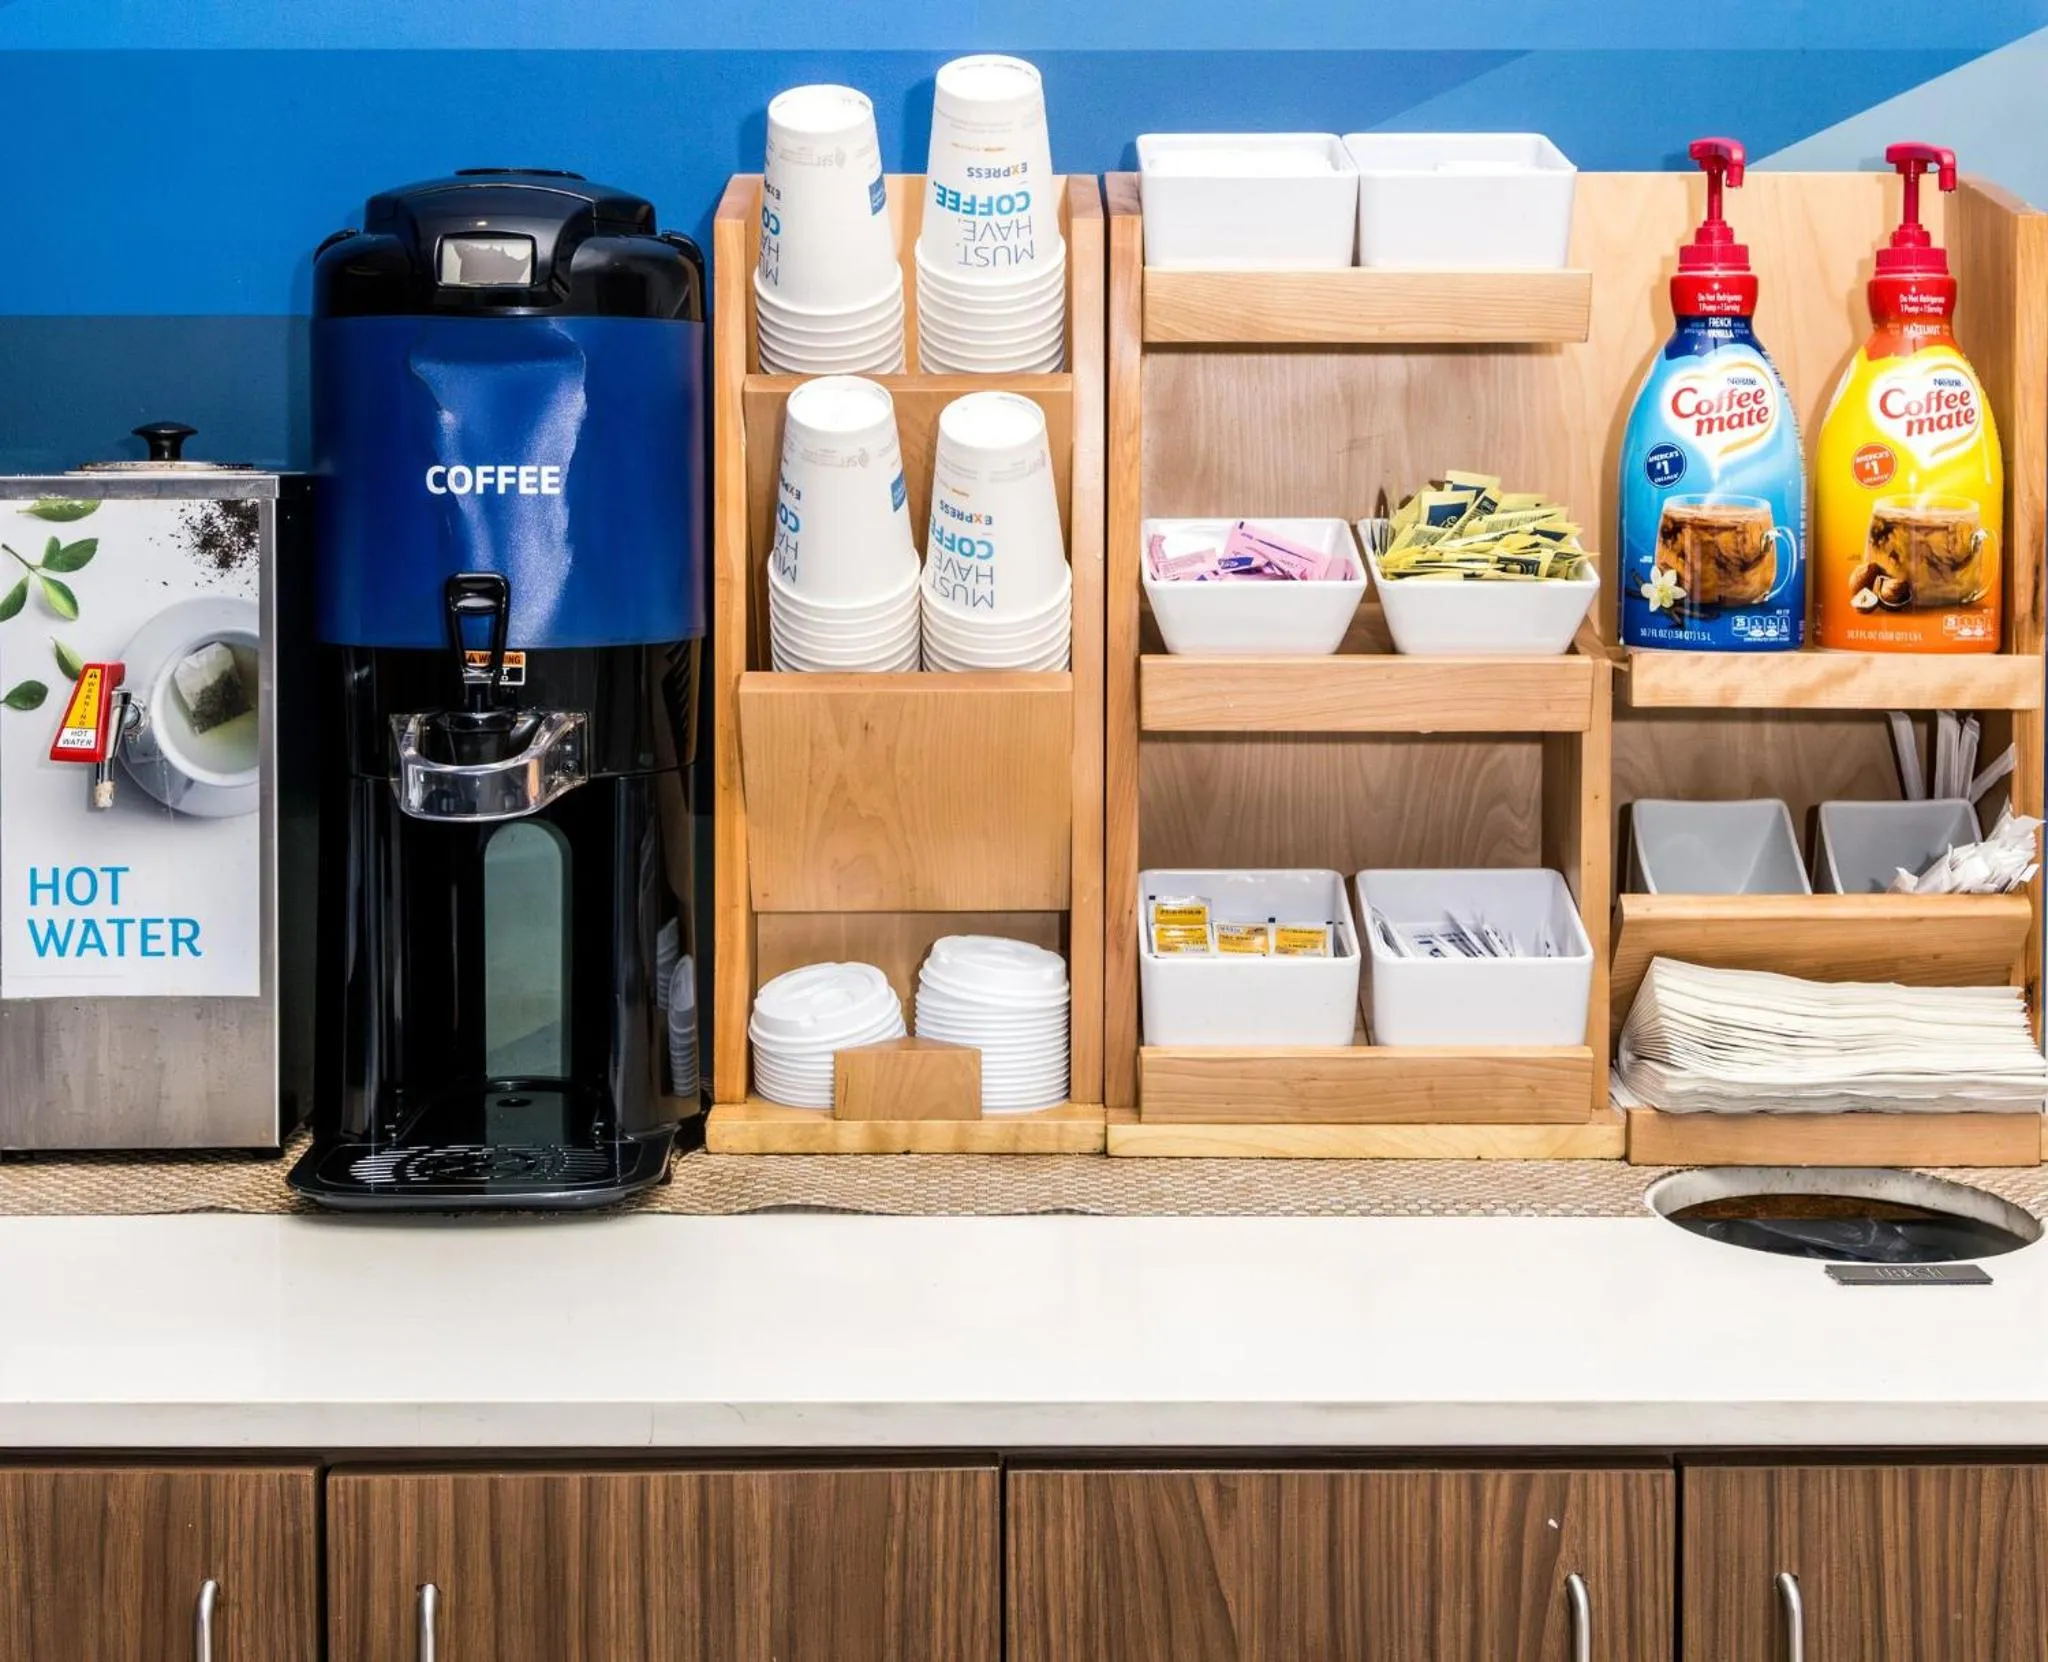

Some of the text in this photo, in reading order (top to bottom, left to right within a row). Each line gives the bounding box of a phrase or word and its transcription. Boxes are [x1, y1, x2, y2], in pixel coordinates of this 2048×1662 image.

[966, 162, 1028, 178] EXPRESS
[933, 180, 1031, 216] COFFEE.
[1707, 328, 1735, 338] VANILLA
[1708, 317, 1732, 328] FRENCH
[1671, 387, 1766, 419] Coffee
[1879, 388, 1971, 419] Coffee
[1695, 405, 1769, 436] mate
[1905, 407, 1976, 437] mate
[426, 465, 561, 494] COFFEE
[1656, 460, 1670, 475] #1
[1864, 460, 1880, 475] #1
[939, 499, 993, 526] EXPRESS
[62, 739, 93, 747] WATER
[70, 730, 89, 738] HOT
[29, 866, 130, 906] HOT
[27, 918, 202, 957] WATER
